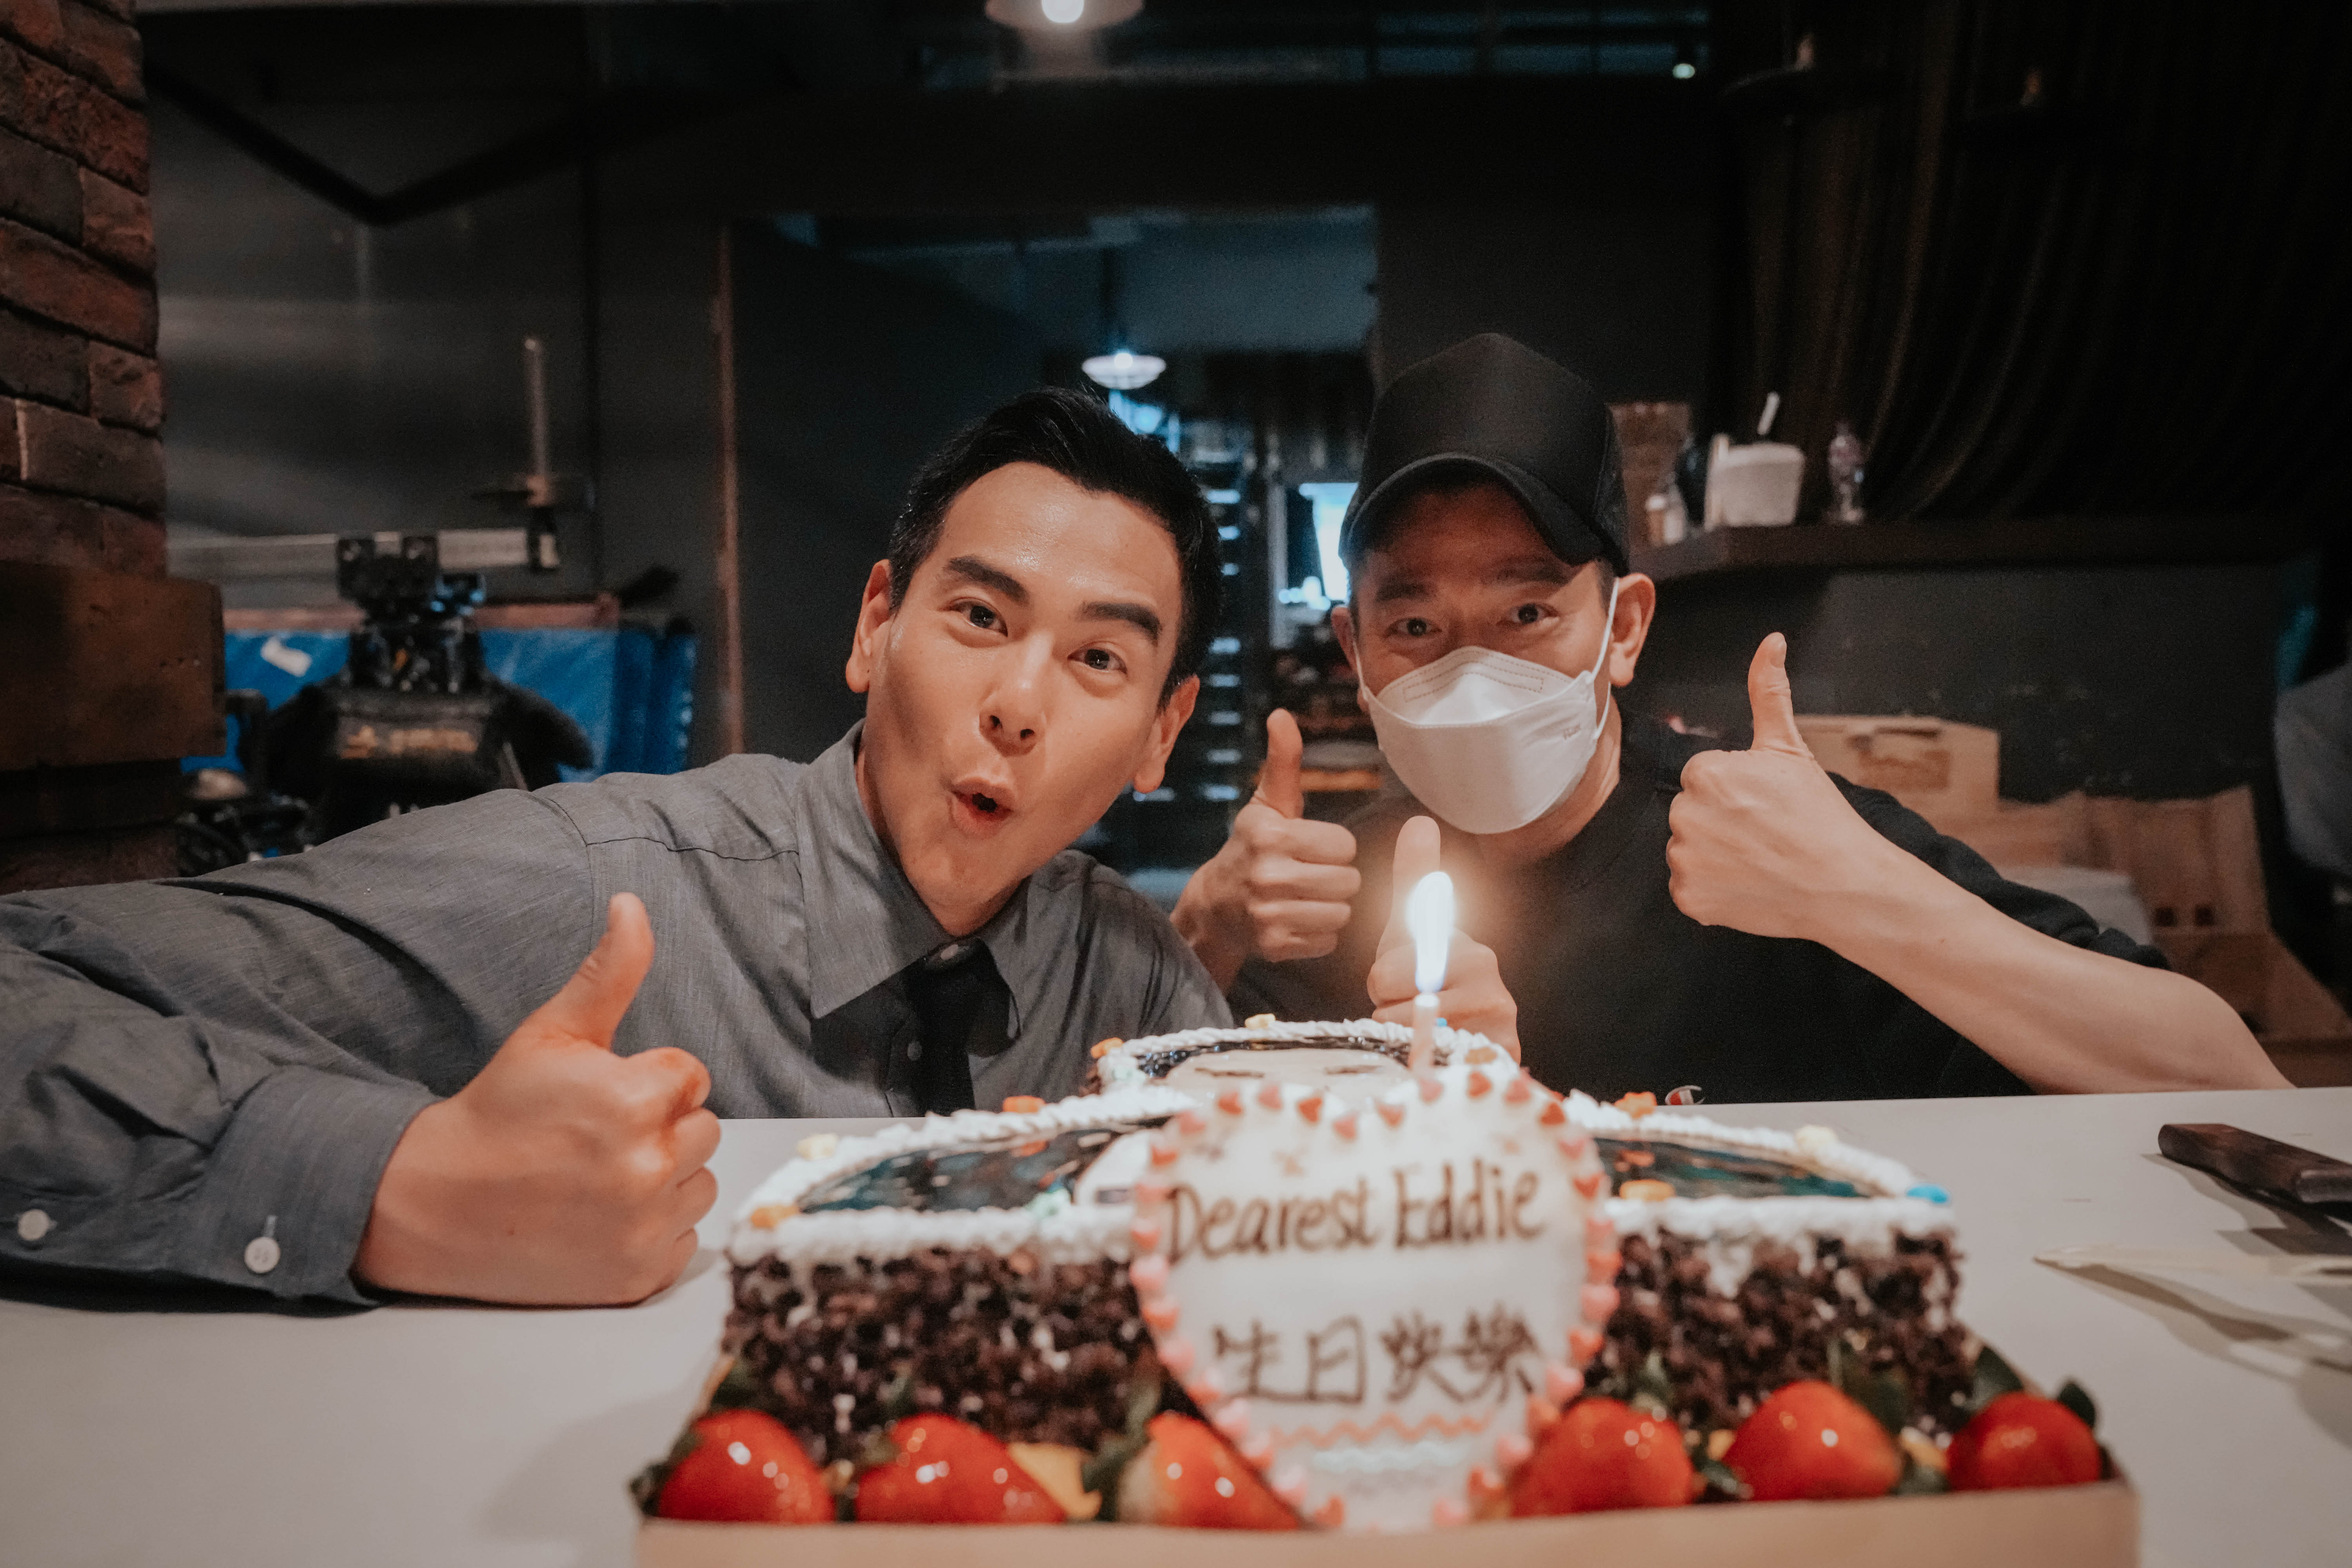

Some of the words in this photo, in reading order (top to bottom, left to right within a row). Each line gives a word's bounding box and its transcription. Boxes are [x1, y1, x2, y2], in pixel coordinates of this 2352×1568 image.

[1167, 1179, 1375, 1263] Dearest
[1392, 1158, 1545, 1248] Eddie
[1212, 1305, 1544, 1403] 生日快樂
